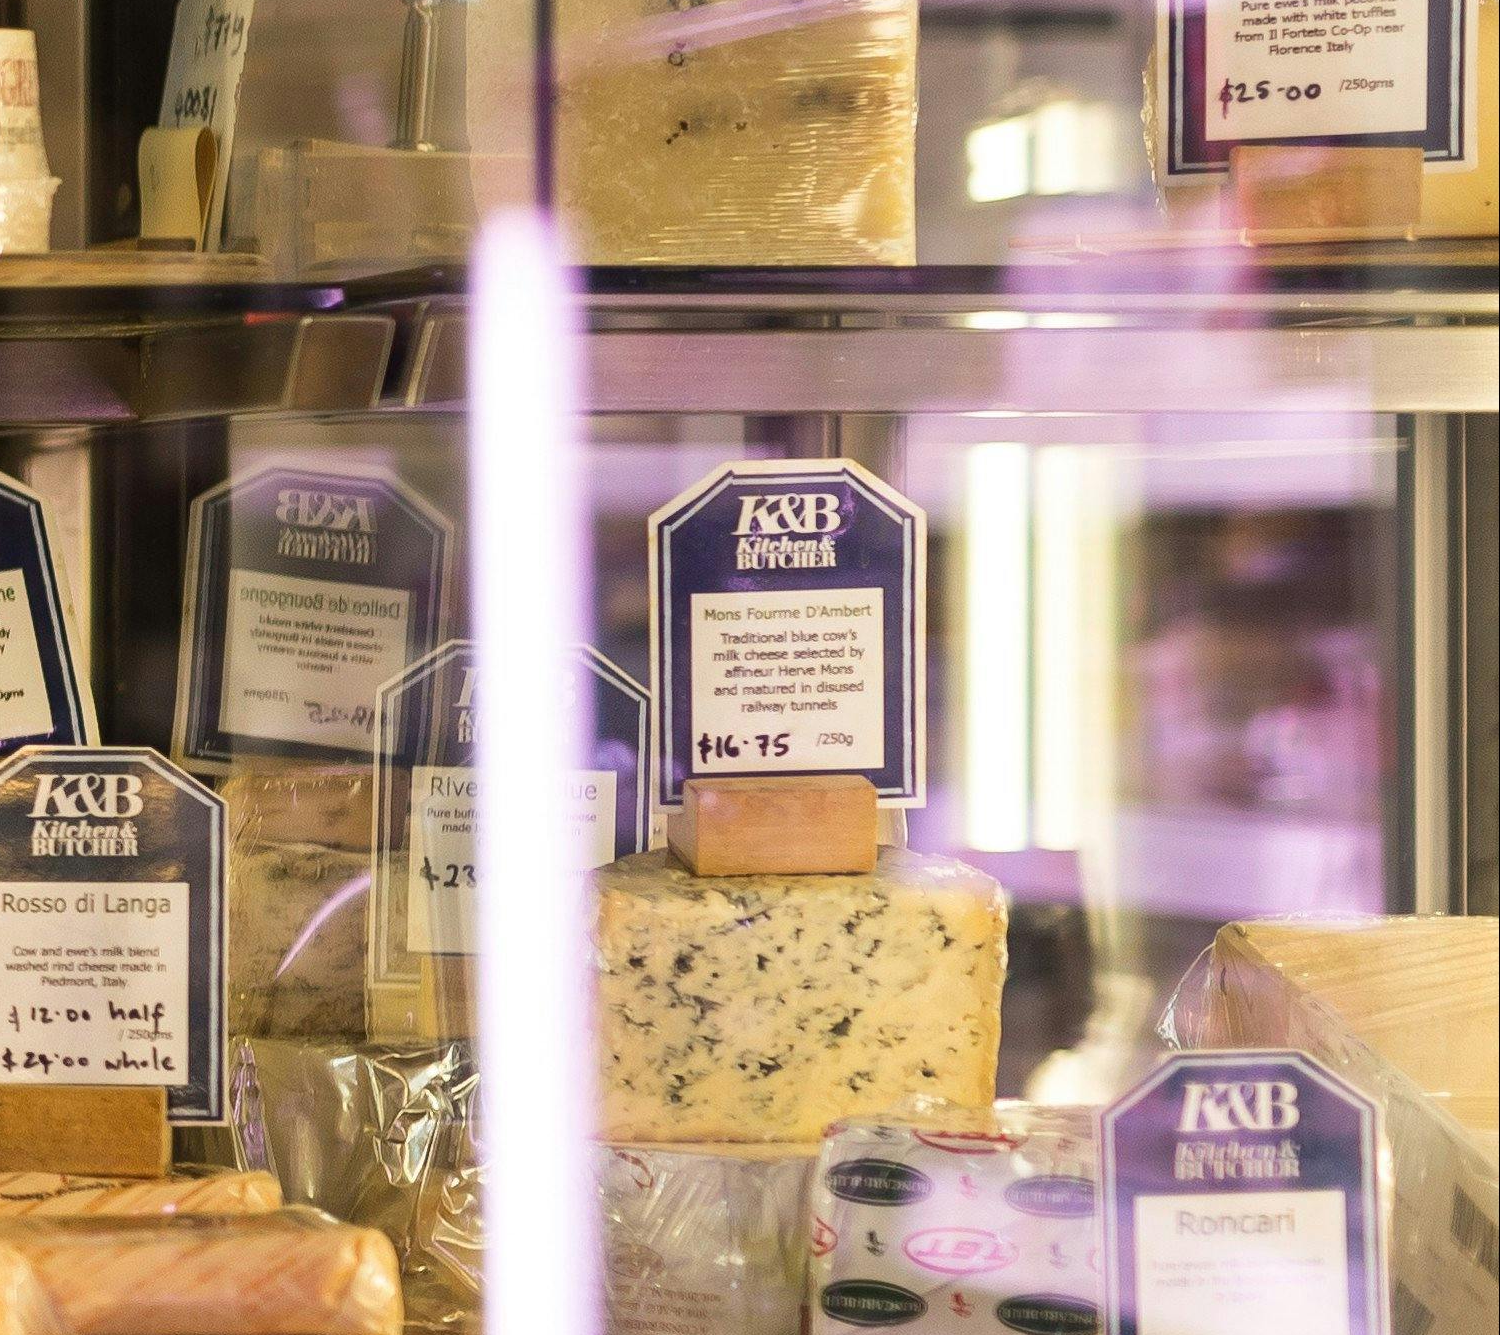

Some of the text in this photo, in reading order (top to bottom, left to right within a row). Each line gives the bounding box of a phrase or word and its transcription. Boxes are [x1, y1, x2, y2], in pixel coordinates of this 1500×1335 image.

[731, 493, 842, 536] K&B
[736, 535, 836, 556] Kitchen&
[736, 551, 837, 570] BUTCHER
[704, 607, 742, 621] Mons
[747, 607, 801, 620] Fourme
[720, 632, 788, 644] Traditional
[792, 630, 819, 643] blue
[27, 772, 144, 819] K&B
[1, 892, 172, 919] Rosso di Langa
[107, 1000, 166, 1035] half
[1174, 1207, 1296, 1237] Roncari
